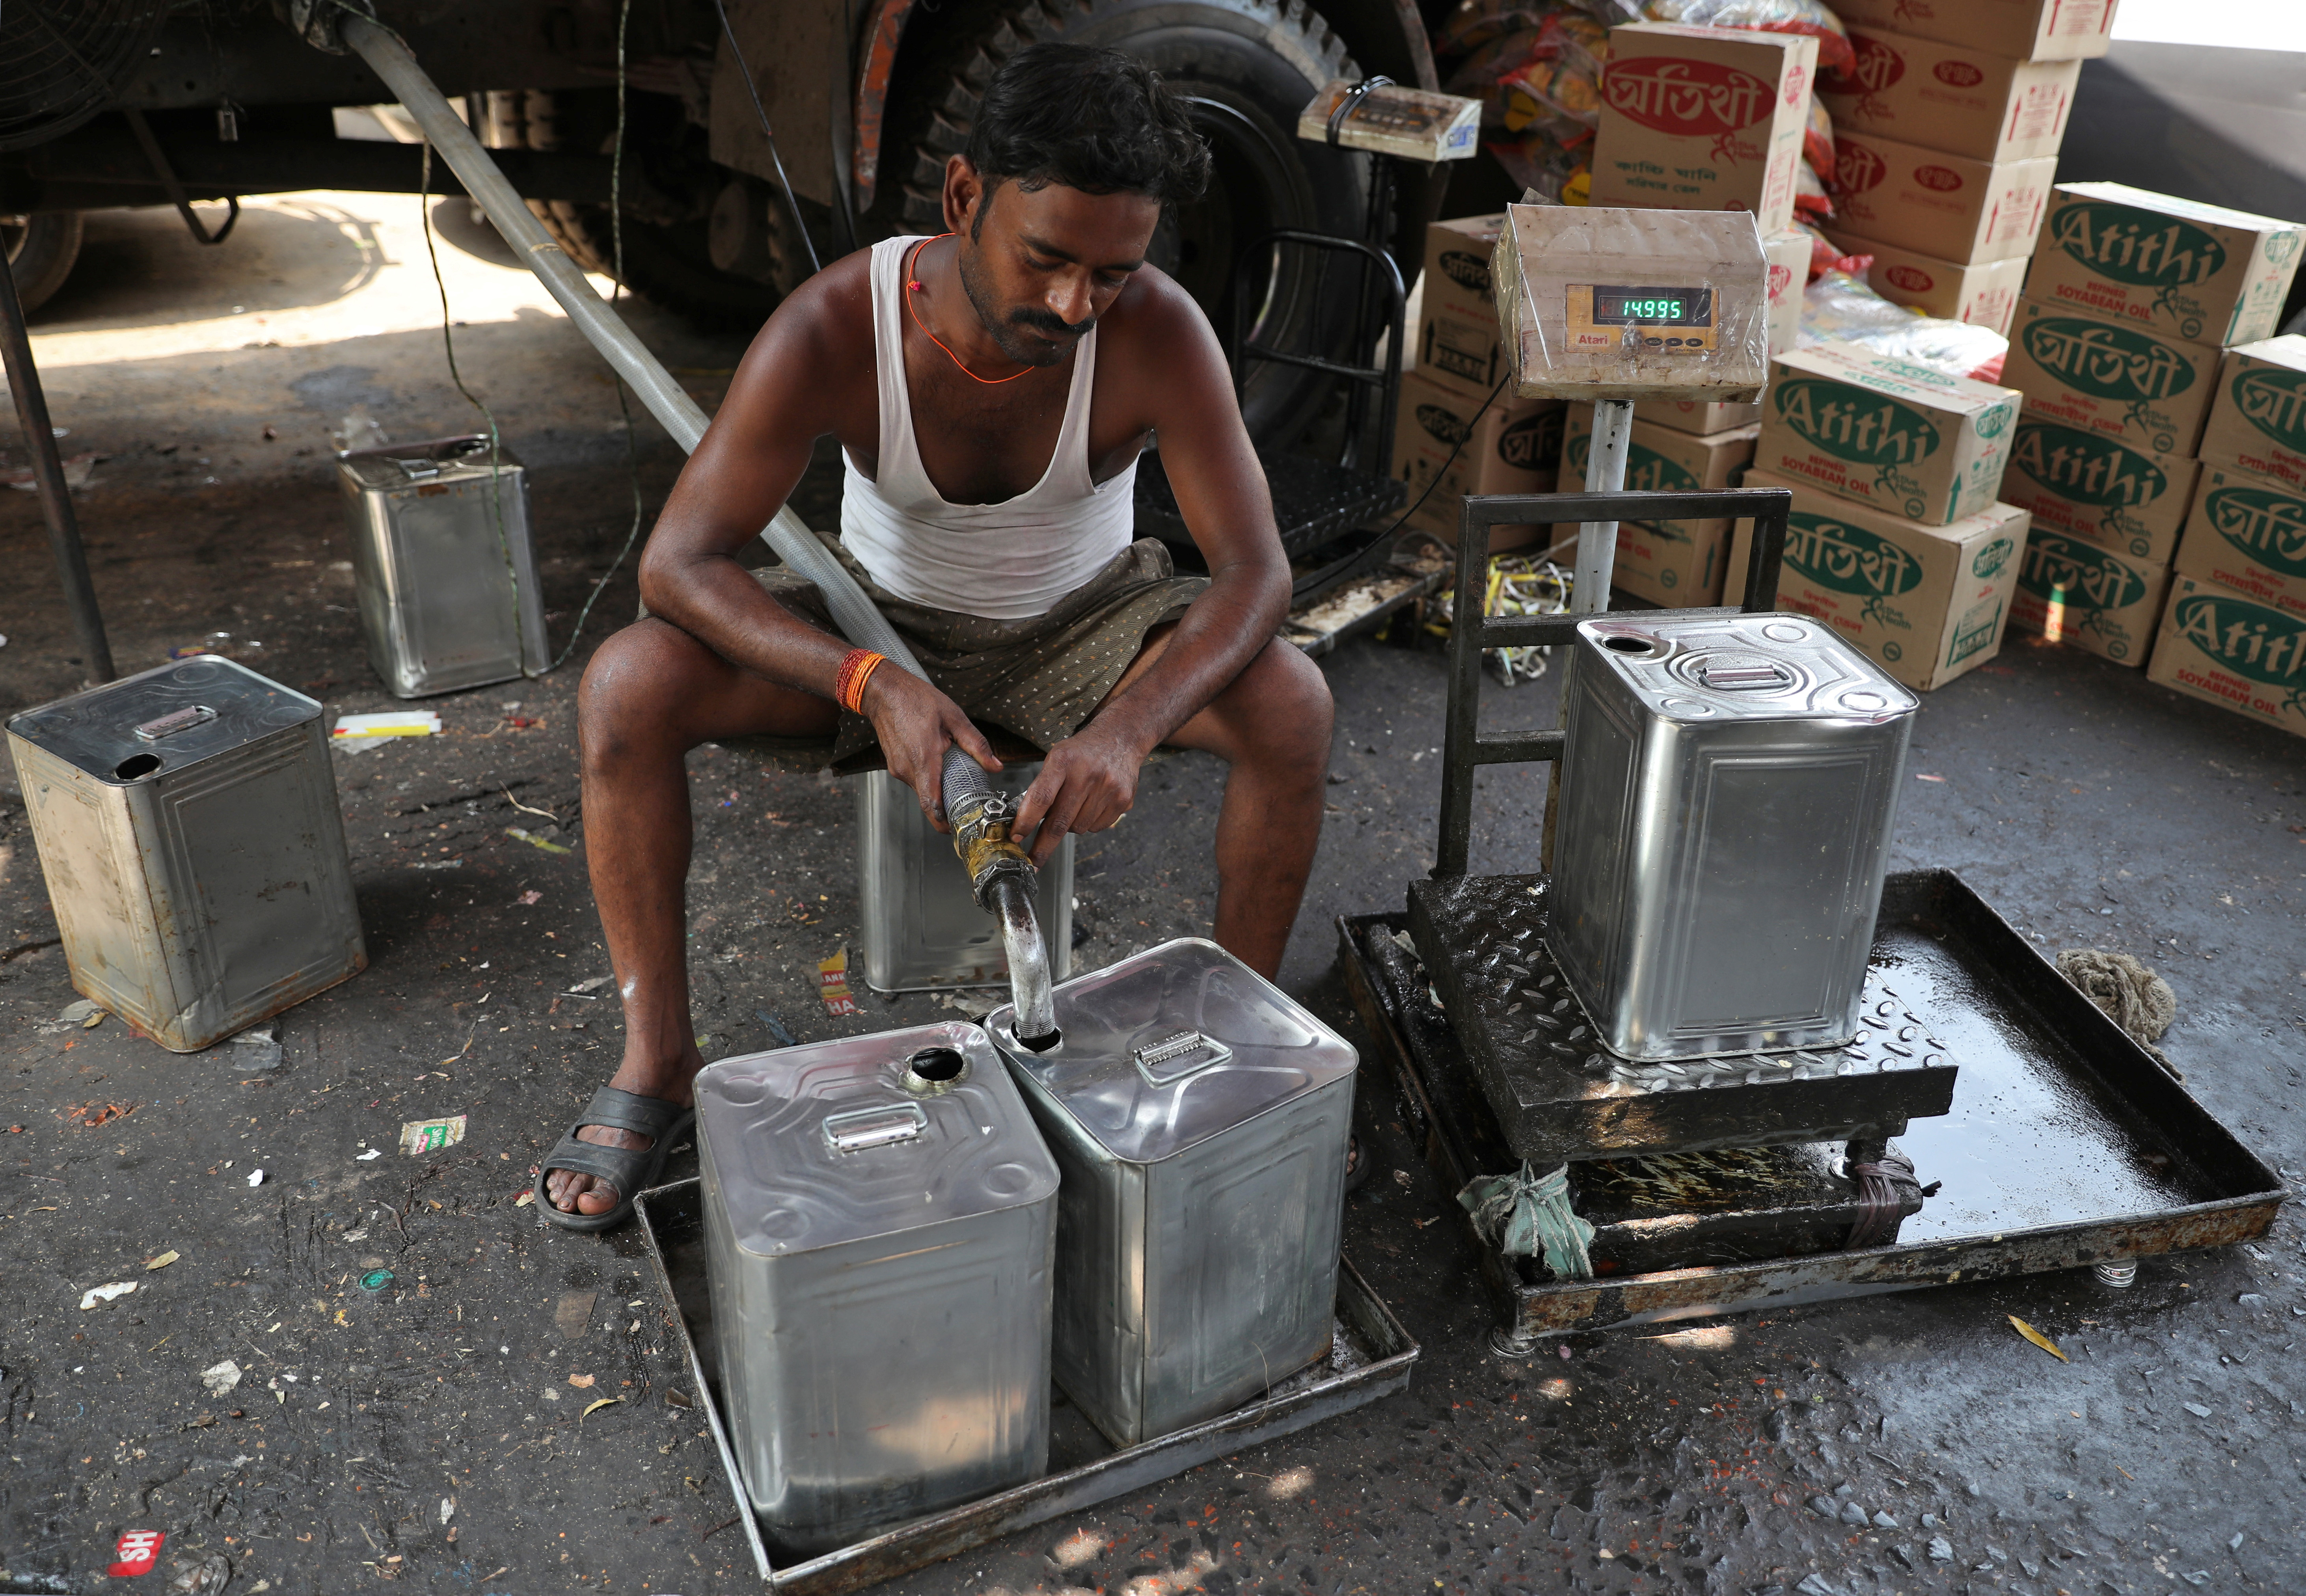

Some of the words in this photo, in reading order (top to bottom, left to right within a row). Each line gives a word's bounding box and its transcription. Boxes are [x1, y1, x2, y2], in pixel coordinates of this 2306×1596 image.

[2049, 210, 2217, 287] Atithi
[1623, 301, 1681, 318] 14.995
[2055, 284, 2126, 313] SOYABEAN
[2129, 304, 2151, 320] OIL
[1578, 335, 1608, 345] Atari
[1775, 386, 1930, 467] Atithi
[1781, 455, 1846, 486] SOYABEAN
[1850, 479, 1870, 495] OIL
[2010, 431, 2158, 508] Atithi
[2177, 669, 2251, 704] SOYABEAN
[2253, 698, 2277, 715] OIL
[2209, 670, 2251, 692] REFINED
